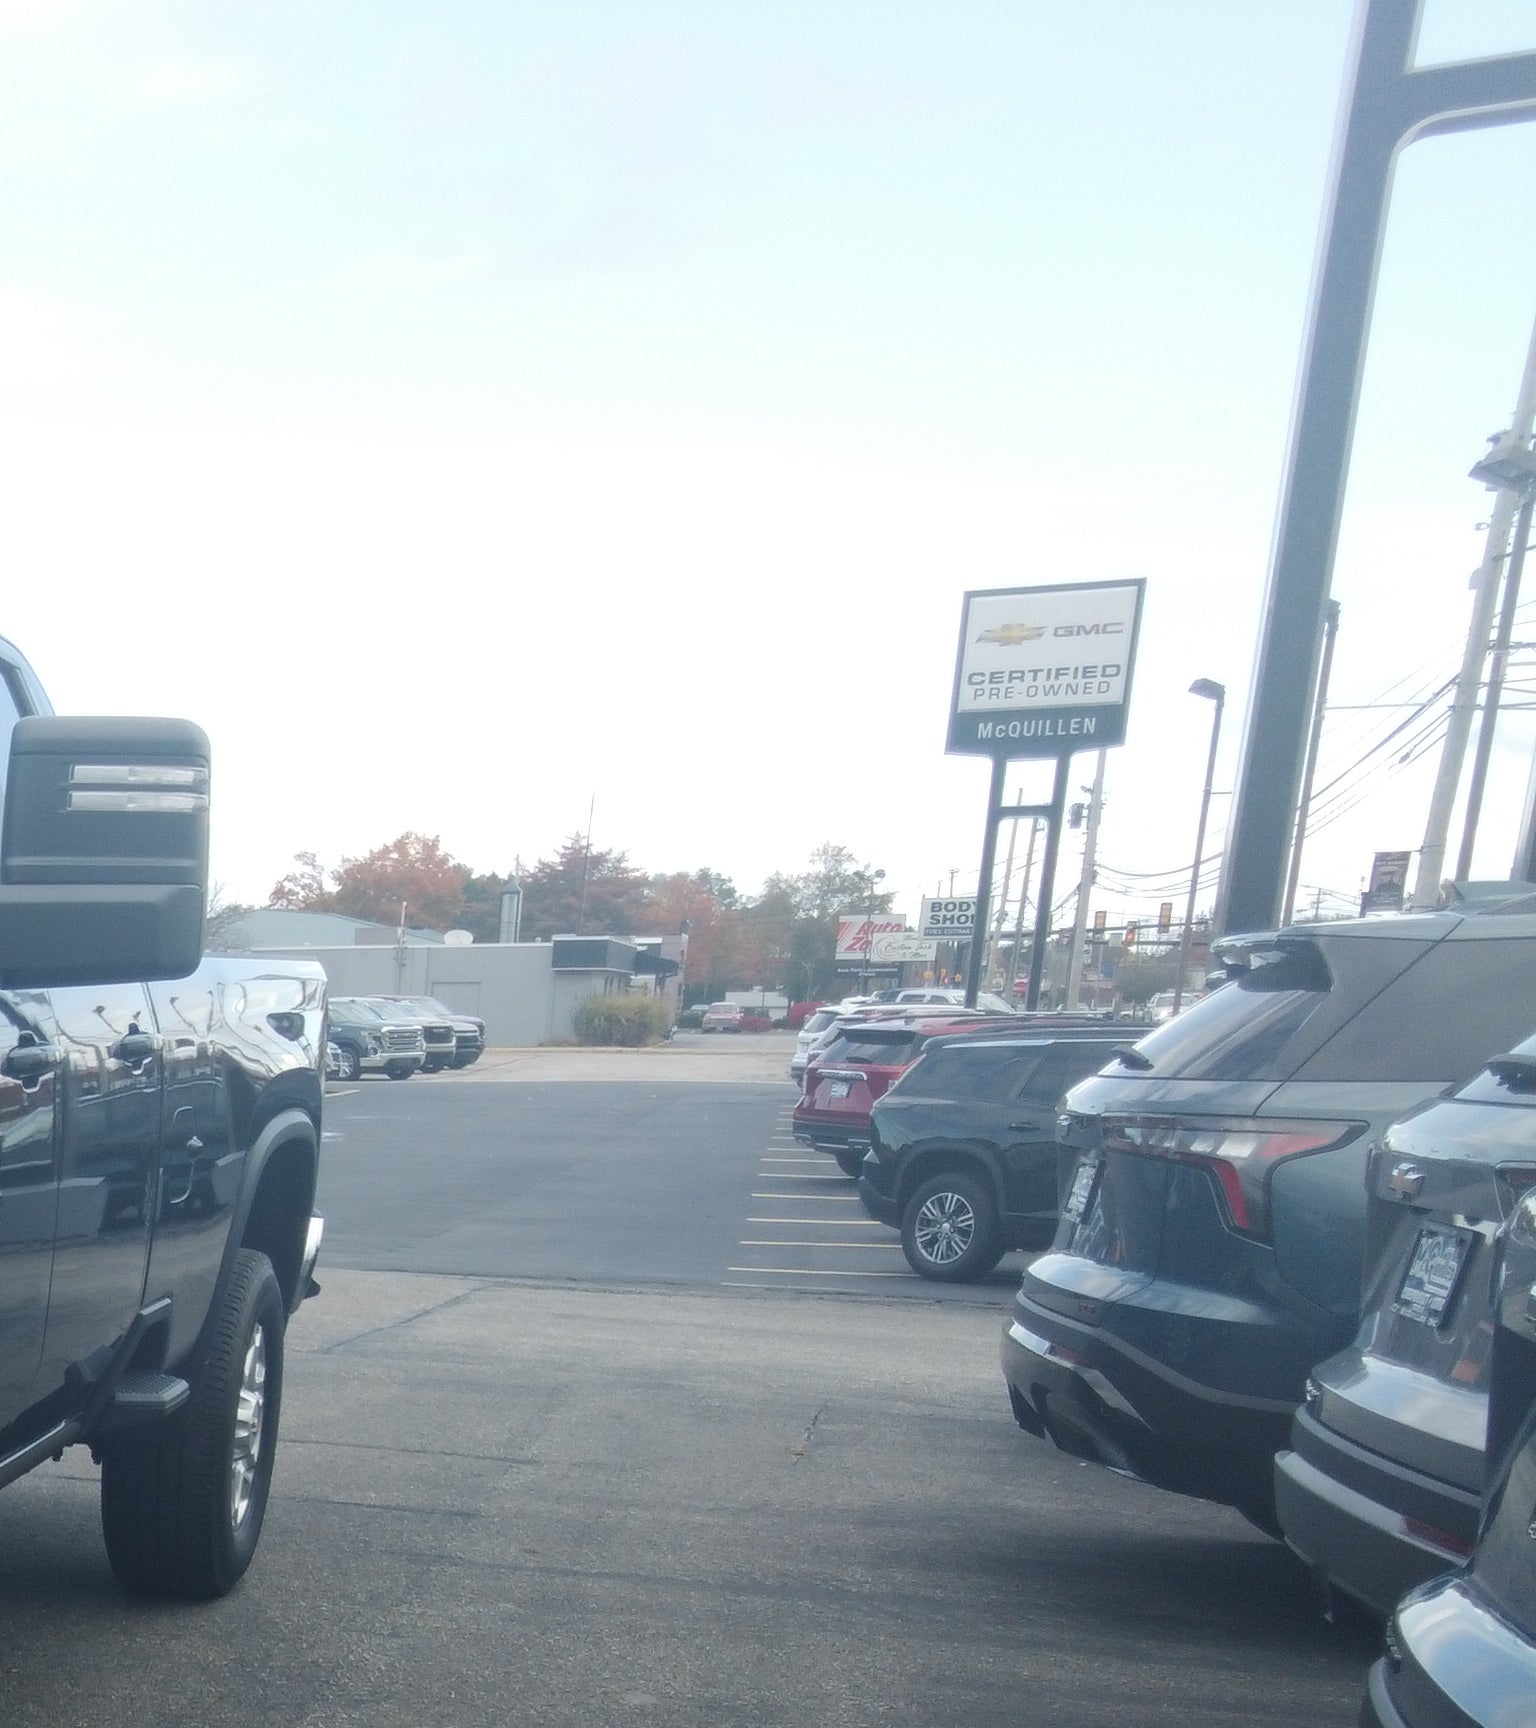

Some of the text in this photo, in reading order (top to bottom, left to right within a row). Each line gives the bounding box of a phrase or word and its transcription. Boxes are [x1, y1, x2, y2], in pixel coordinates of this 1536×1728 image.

[1052, 622, 1125, 638] GMC
[966, 663, 1122, 686] CERTIFIED
[973, 680, 1111, 701] PRE-OWNED
[977, 717, 1097, 739] McQUILLEN
[855, 921, 903, 936] Auto
[844, 937, 872, 951] Zo
